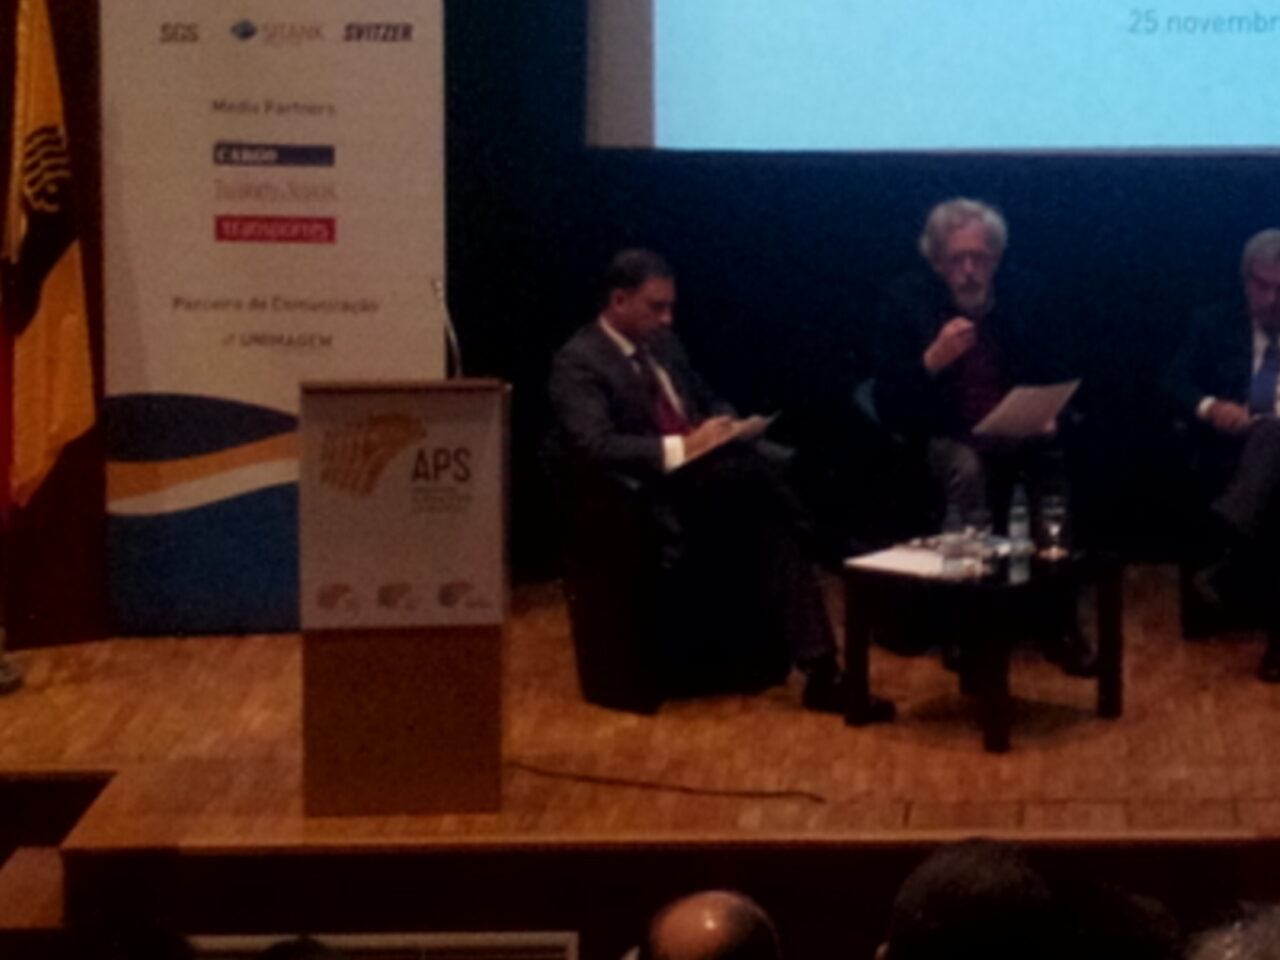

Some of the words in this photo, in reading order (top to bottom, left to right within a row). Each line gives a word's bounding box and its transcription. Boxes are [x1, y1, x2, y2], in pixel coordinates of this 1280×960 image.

[343, 23, 414, 42] SVITZER
[1128, 9, 1158, 34] 25
[412, 448, 472, 483] APS
